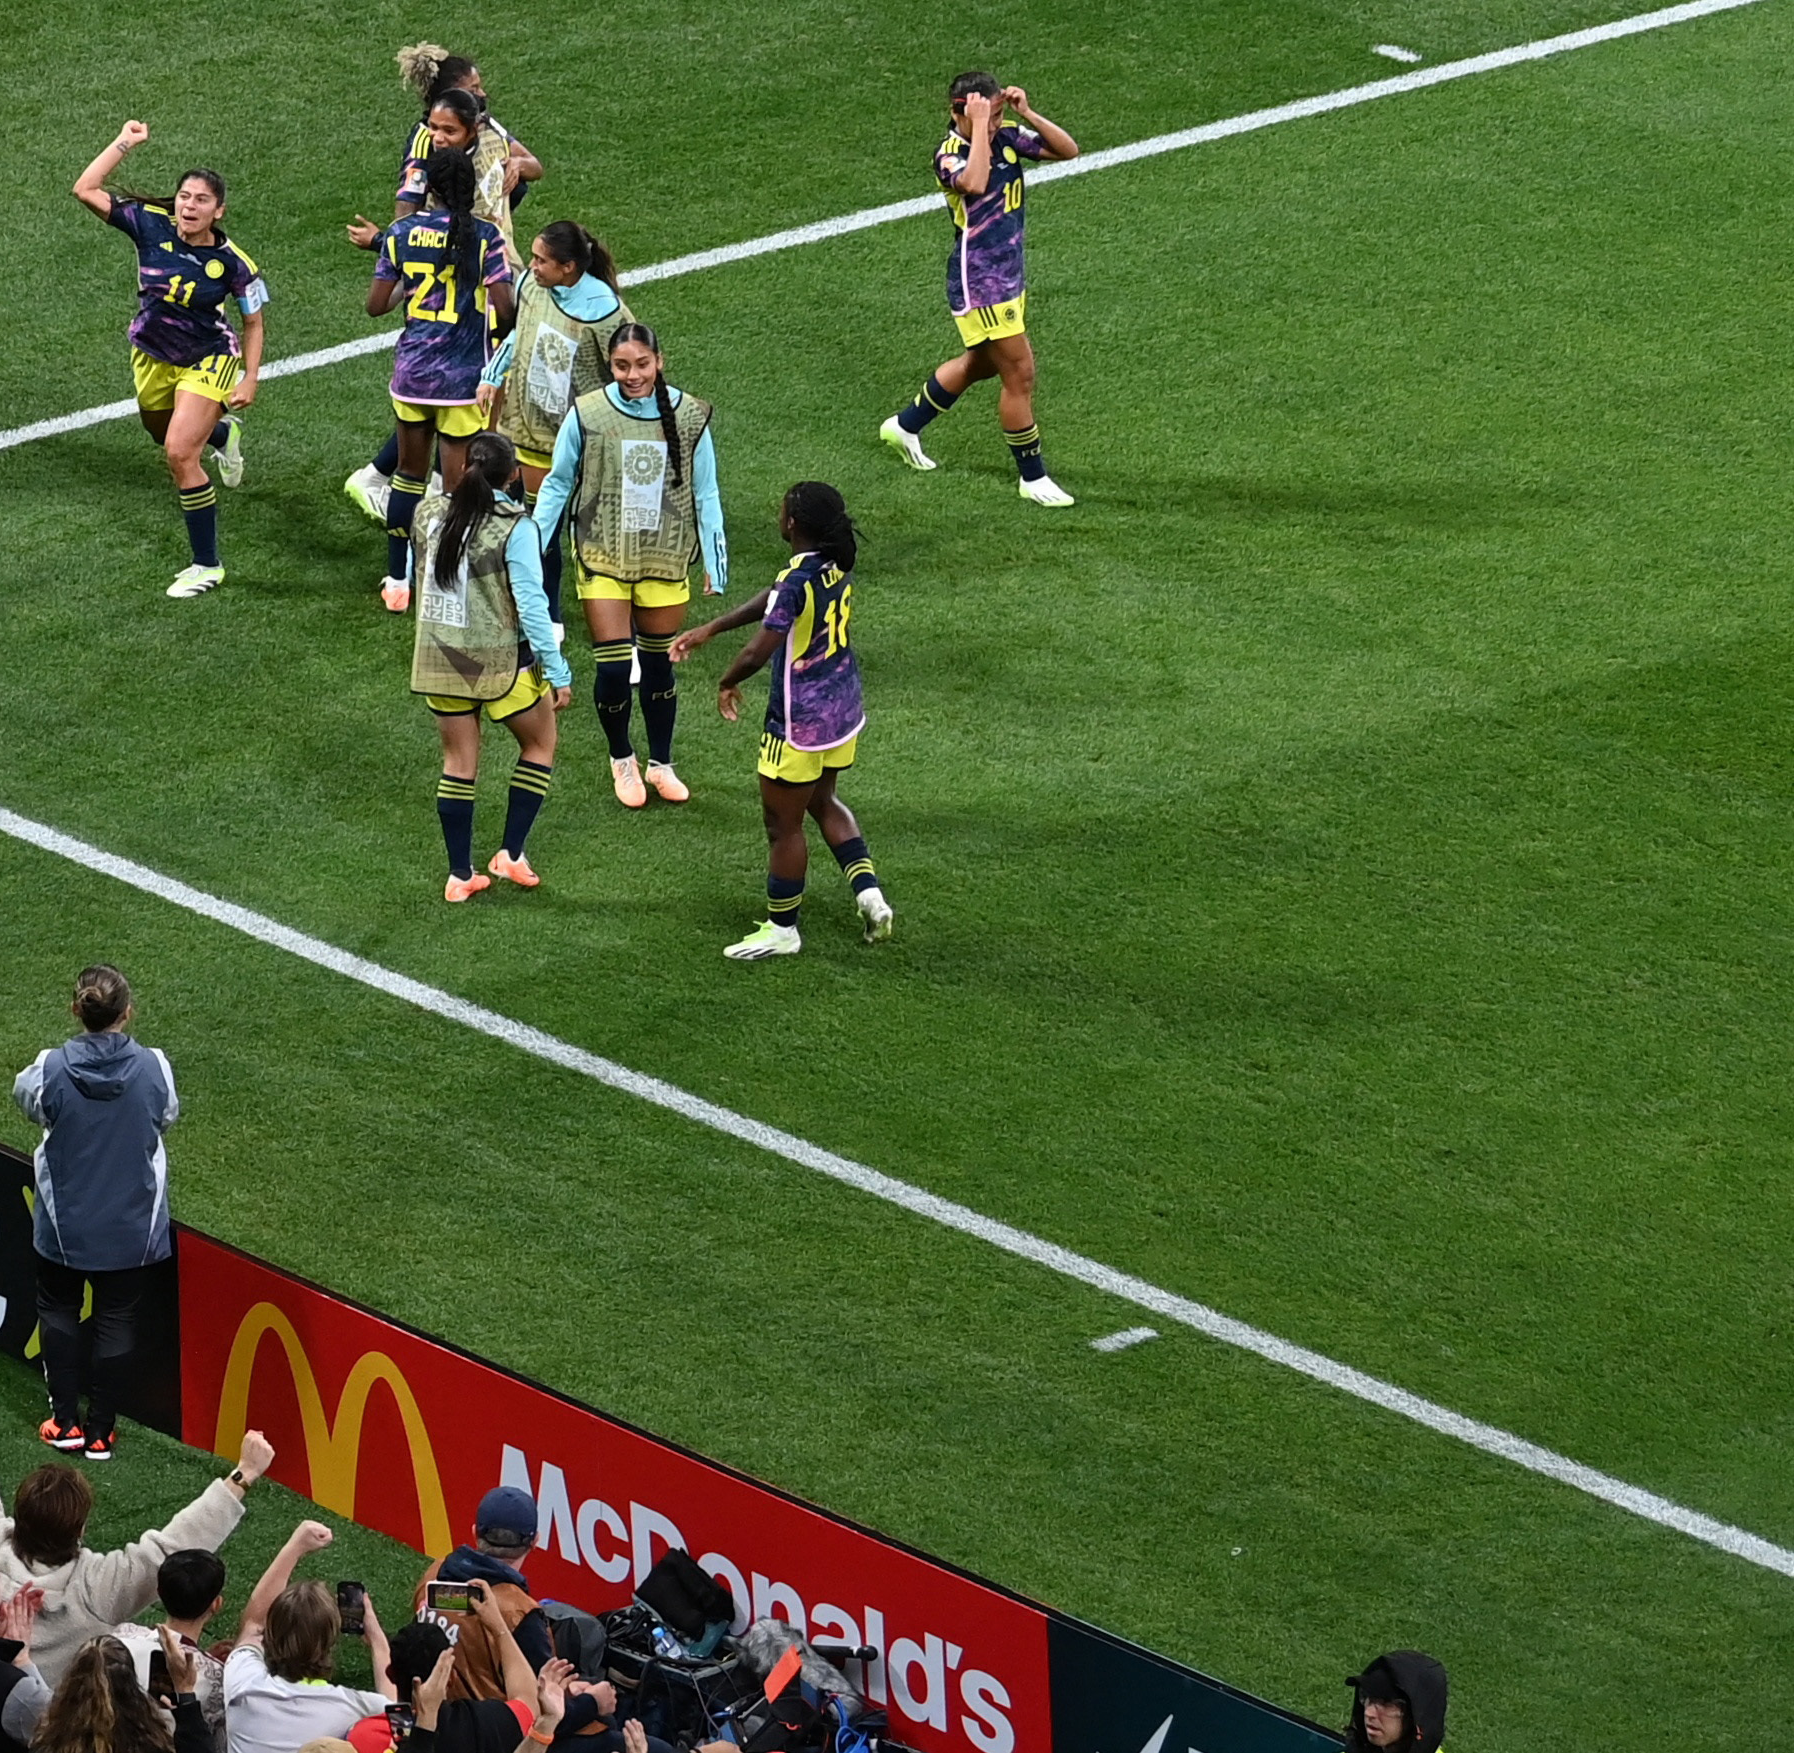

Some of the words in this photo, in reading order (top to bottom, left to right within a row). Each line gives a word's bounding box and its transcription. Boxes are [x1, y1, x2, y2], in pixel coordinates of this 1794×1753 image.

[1002, 177, 1022, 214] 10
[163, 275, 196, 308] 11
[402, 261, 459, 324] 21
